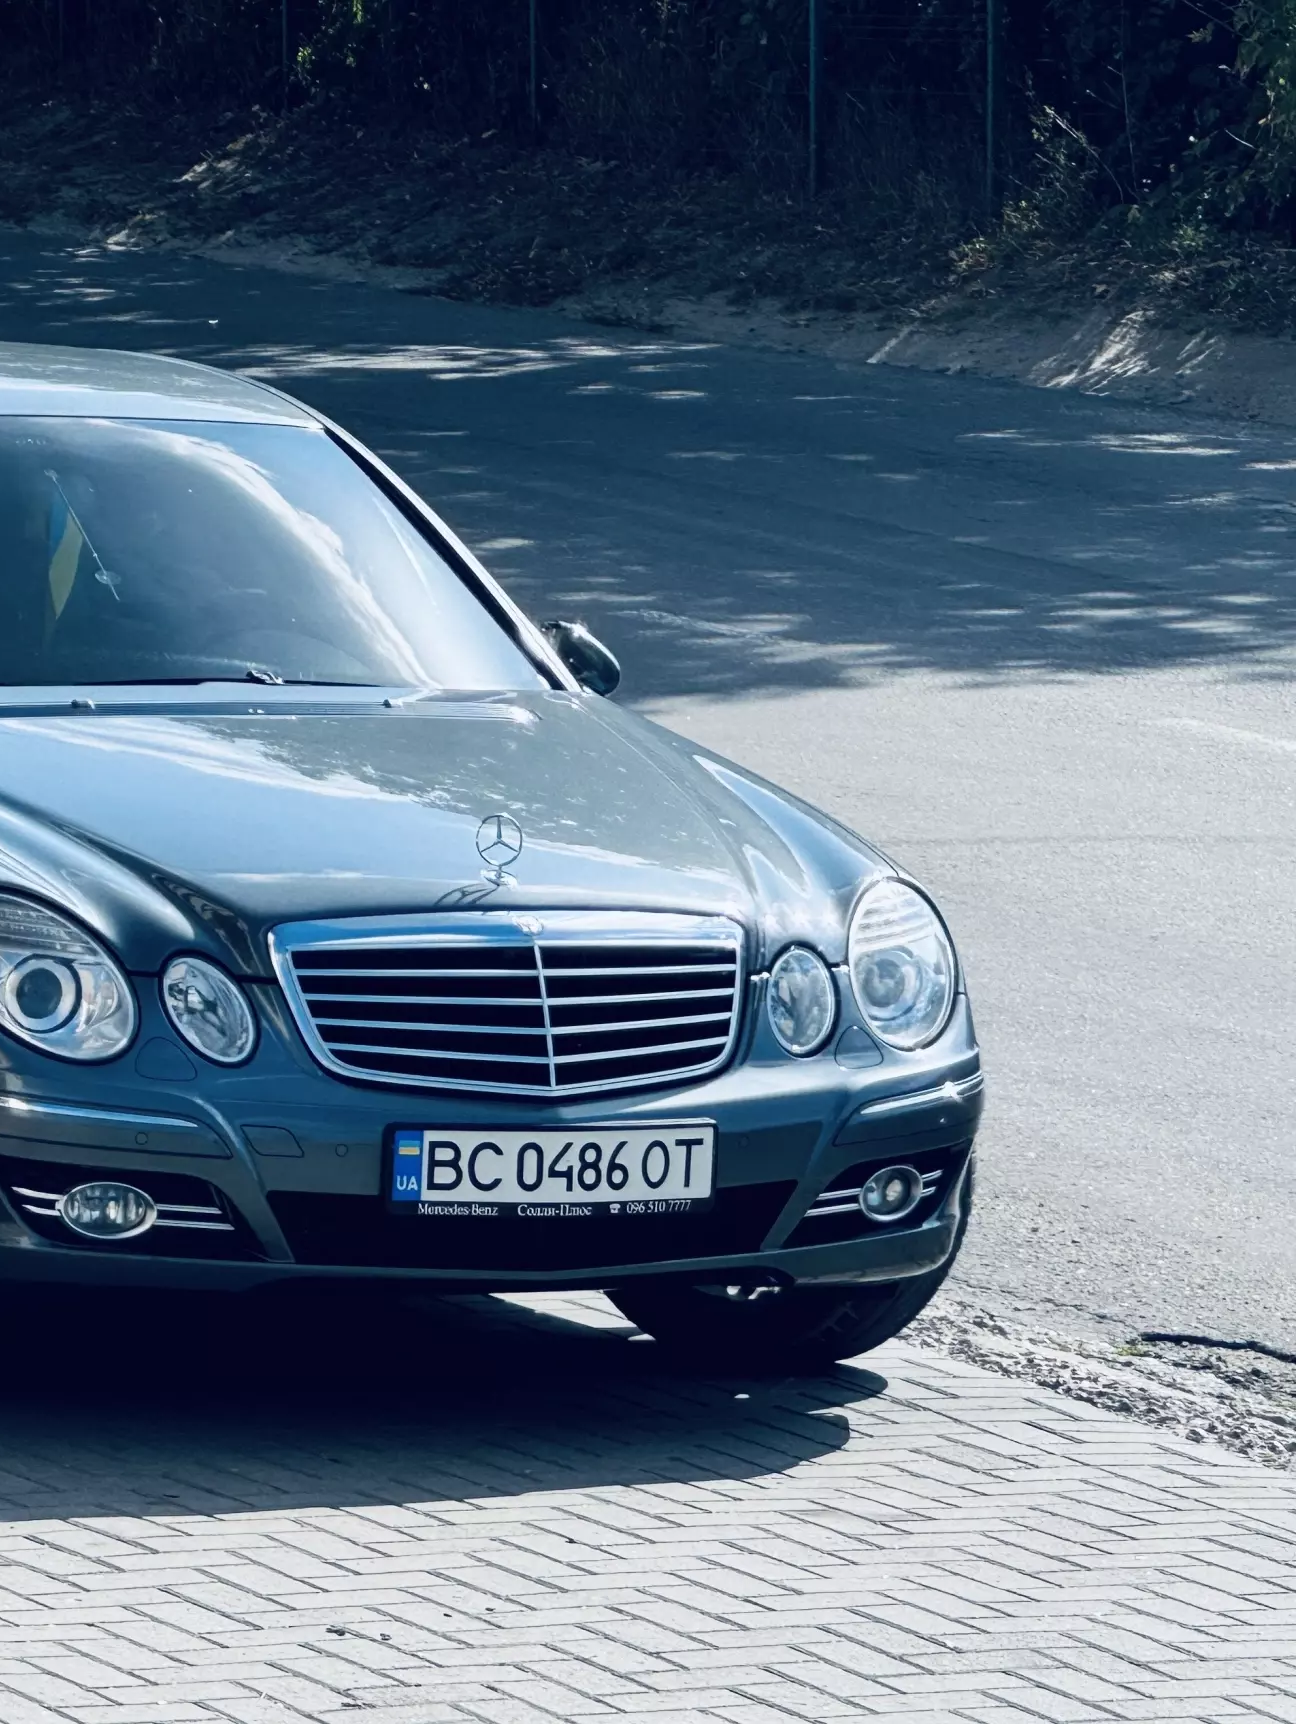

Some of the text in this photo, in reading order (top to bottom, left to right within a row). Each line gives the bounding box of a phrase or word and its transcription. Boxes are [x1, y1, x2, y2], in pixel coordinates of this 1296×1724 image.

[427, 1138, 704, 1192] BC 0486 OT
[396, 1175, 419, 1191] UA
[418, 1203, 499, 1216] Mercedes-Benz
[647, 1200, 666, 1213] 510
[668, 1199, 692, 1212] 7777
